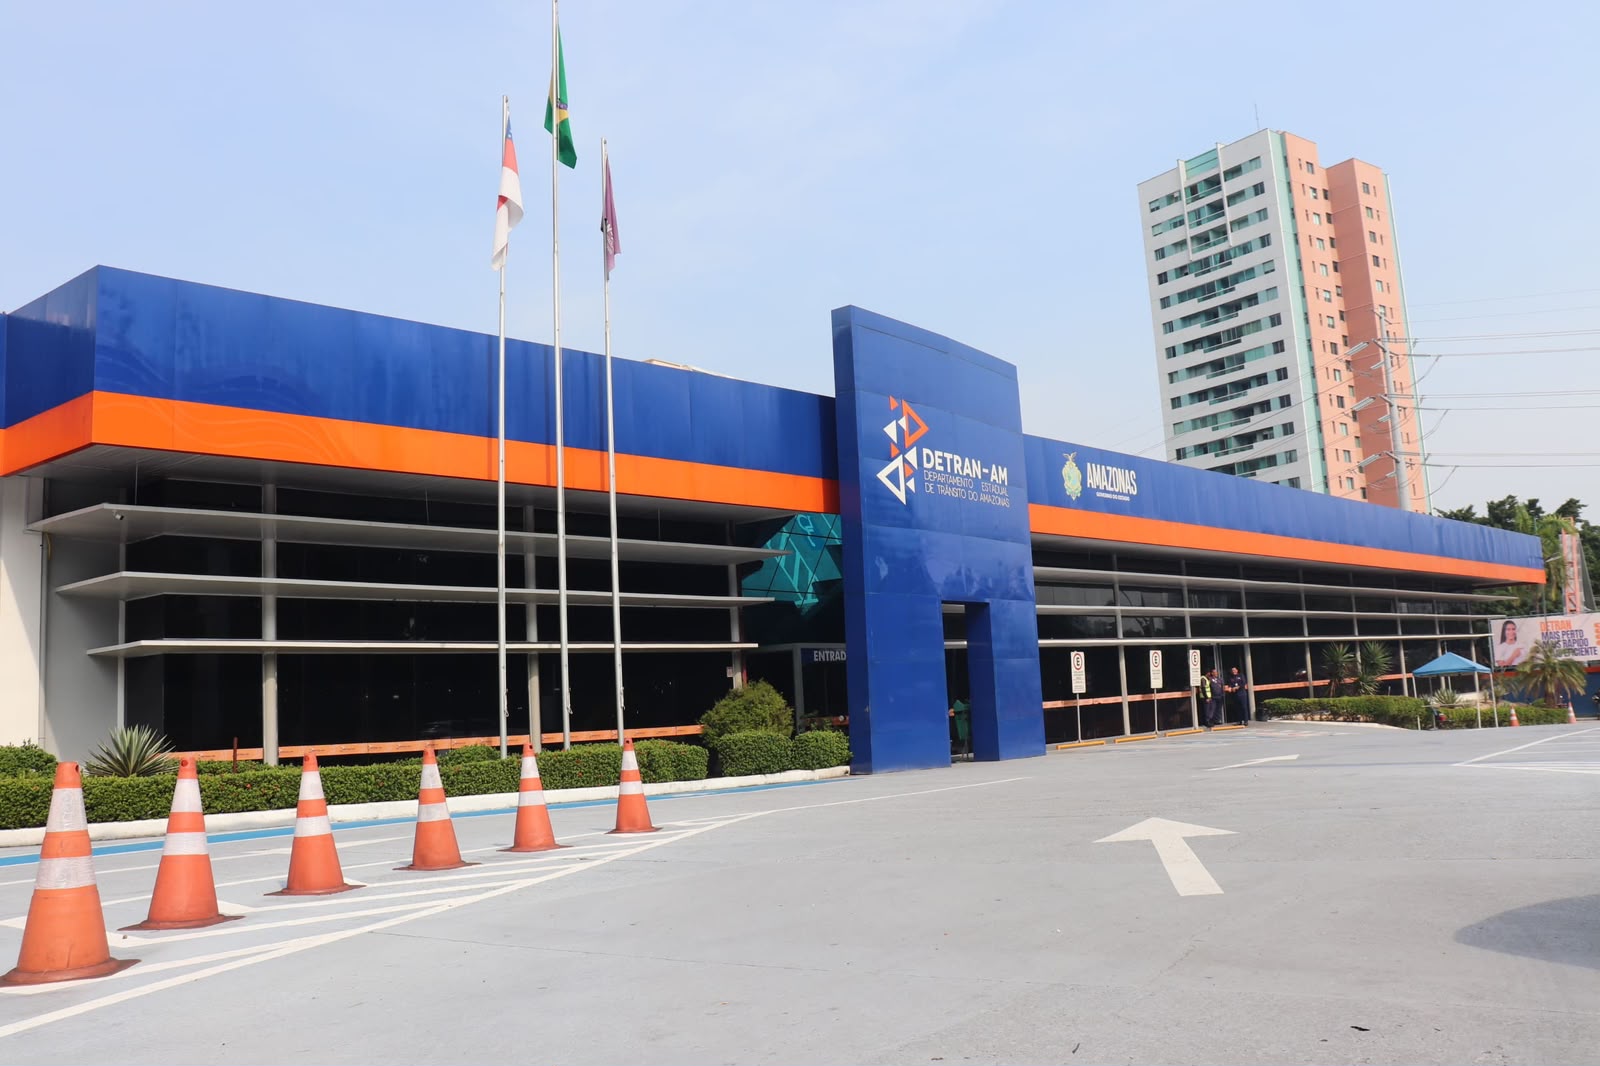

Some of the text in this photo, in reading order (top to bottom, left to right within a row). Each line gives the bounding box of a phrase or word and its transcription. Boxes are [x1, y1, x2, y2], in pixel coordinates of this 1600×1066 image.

[922, 447, 1008, 486] DETRAN-AM
[1086, 462, 1138, 495] AMAZONAS
[923, 470, 1009, 497] DEPARTAMENTO ESTADUAL
[924, 482, 1010, 508] DE TRÂNSITO DO AMAZONAS
[1541, 629, 1584, 640] MAIS PERTO
[813, 650, 847, 662] ENTRAD
